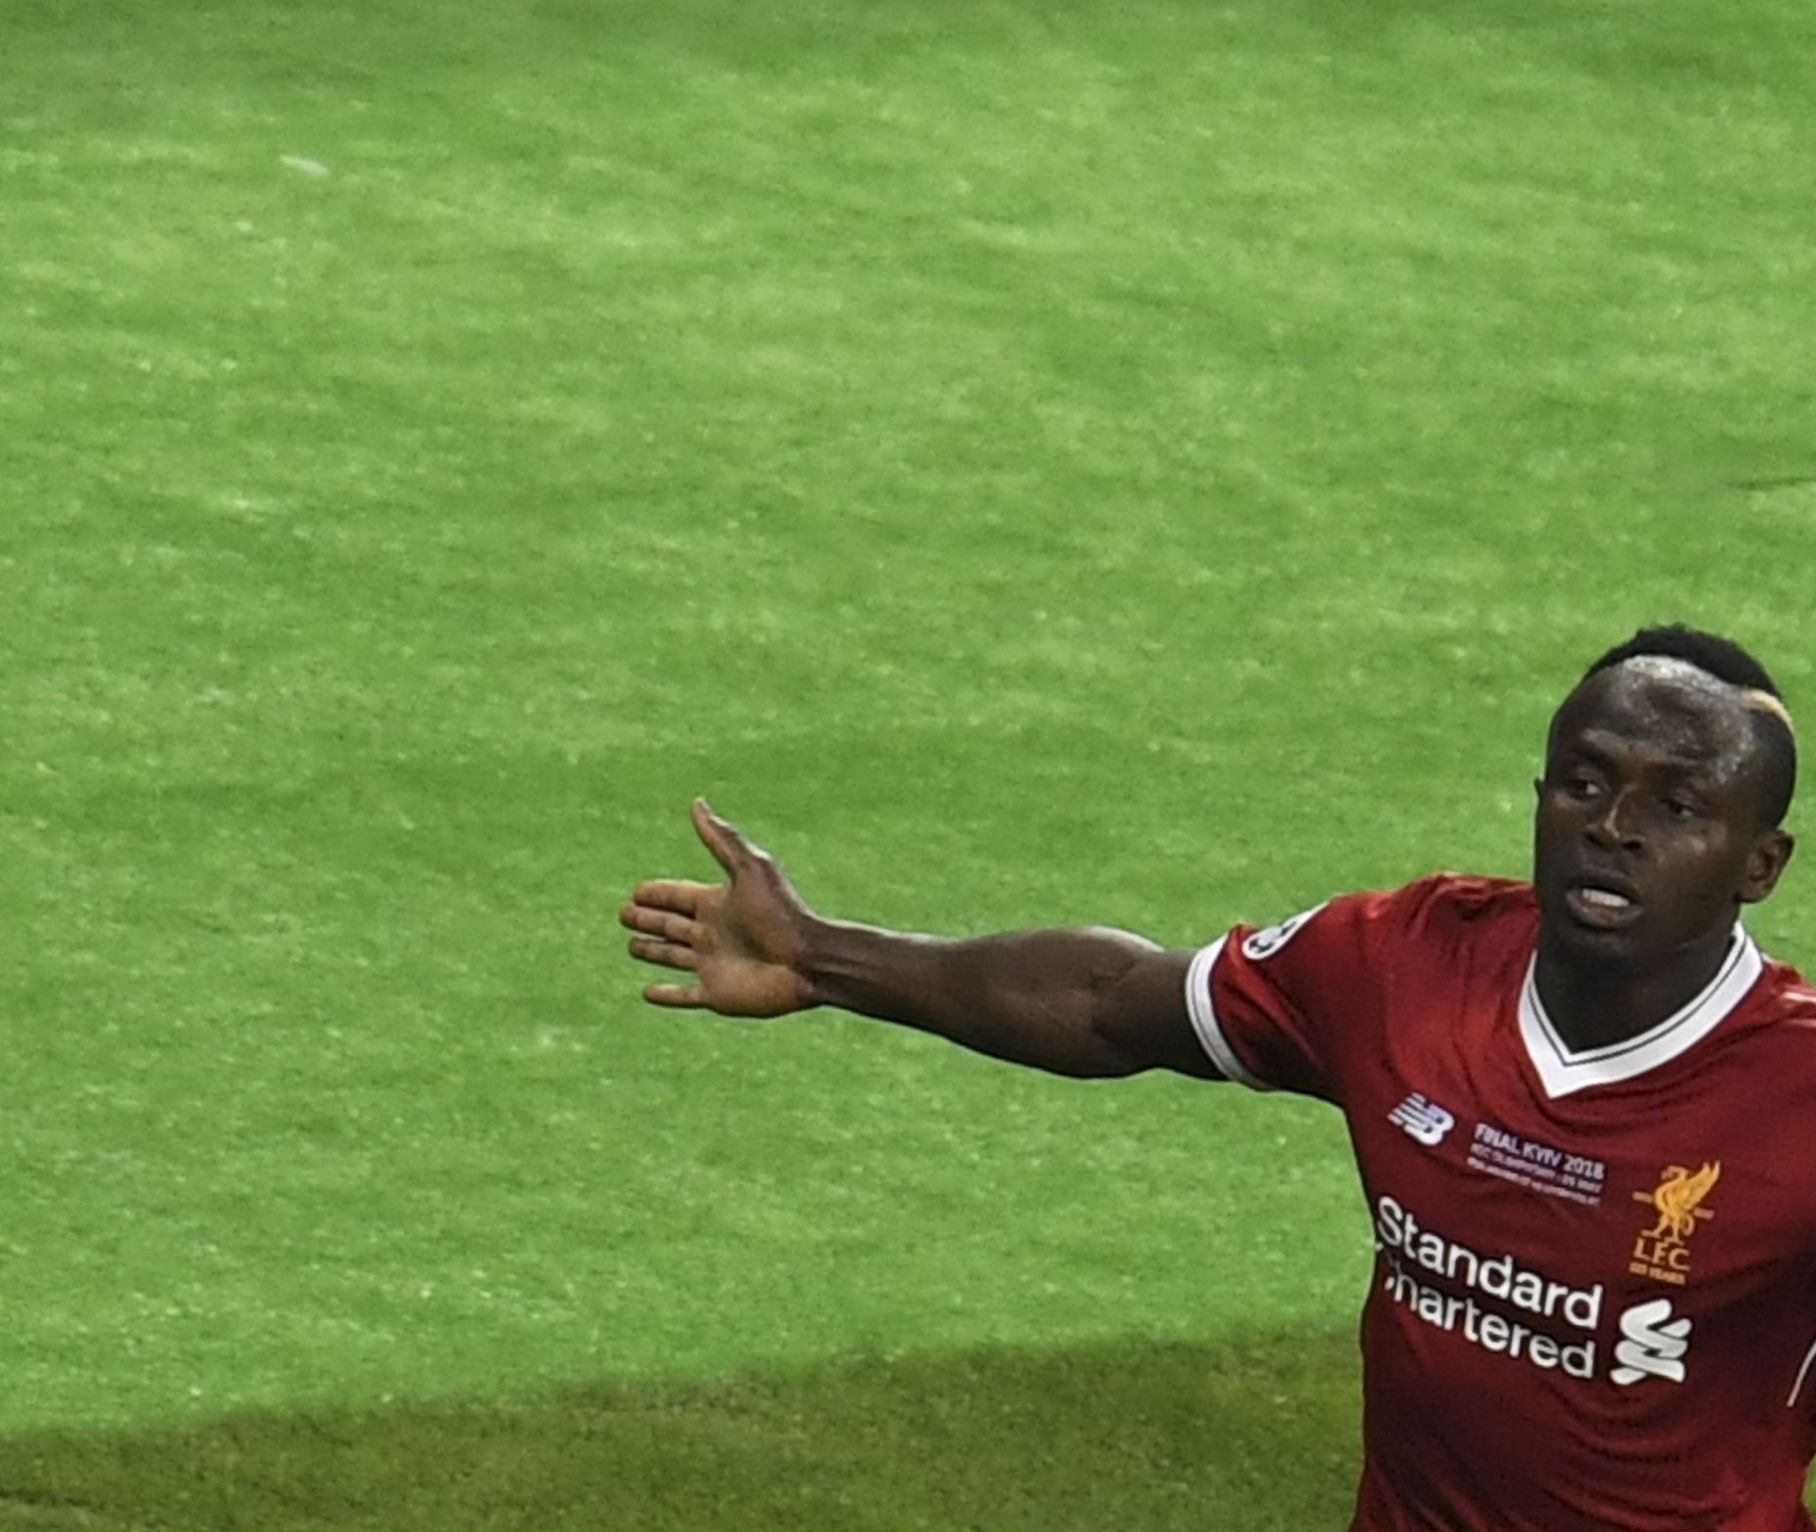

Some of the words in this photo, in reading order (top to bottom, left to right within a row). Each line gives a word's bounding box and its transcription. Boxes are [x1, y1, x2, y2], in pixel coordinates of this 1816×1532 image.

[1376, 1195, 1604, 1330] Standard
[1633, 1237, 1691, 1272] LFC
[1384, 1268, 1597, 1379] hartered
